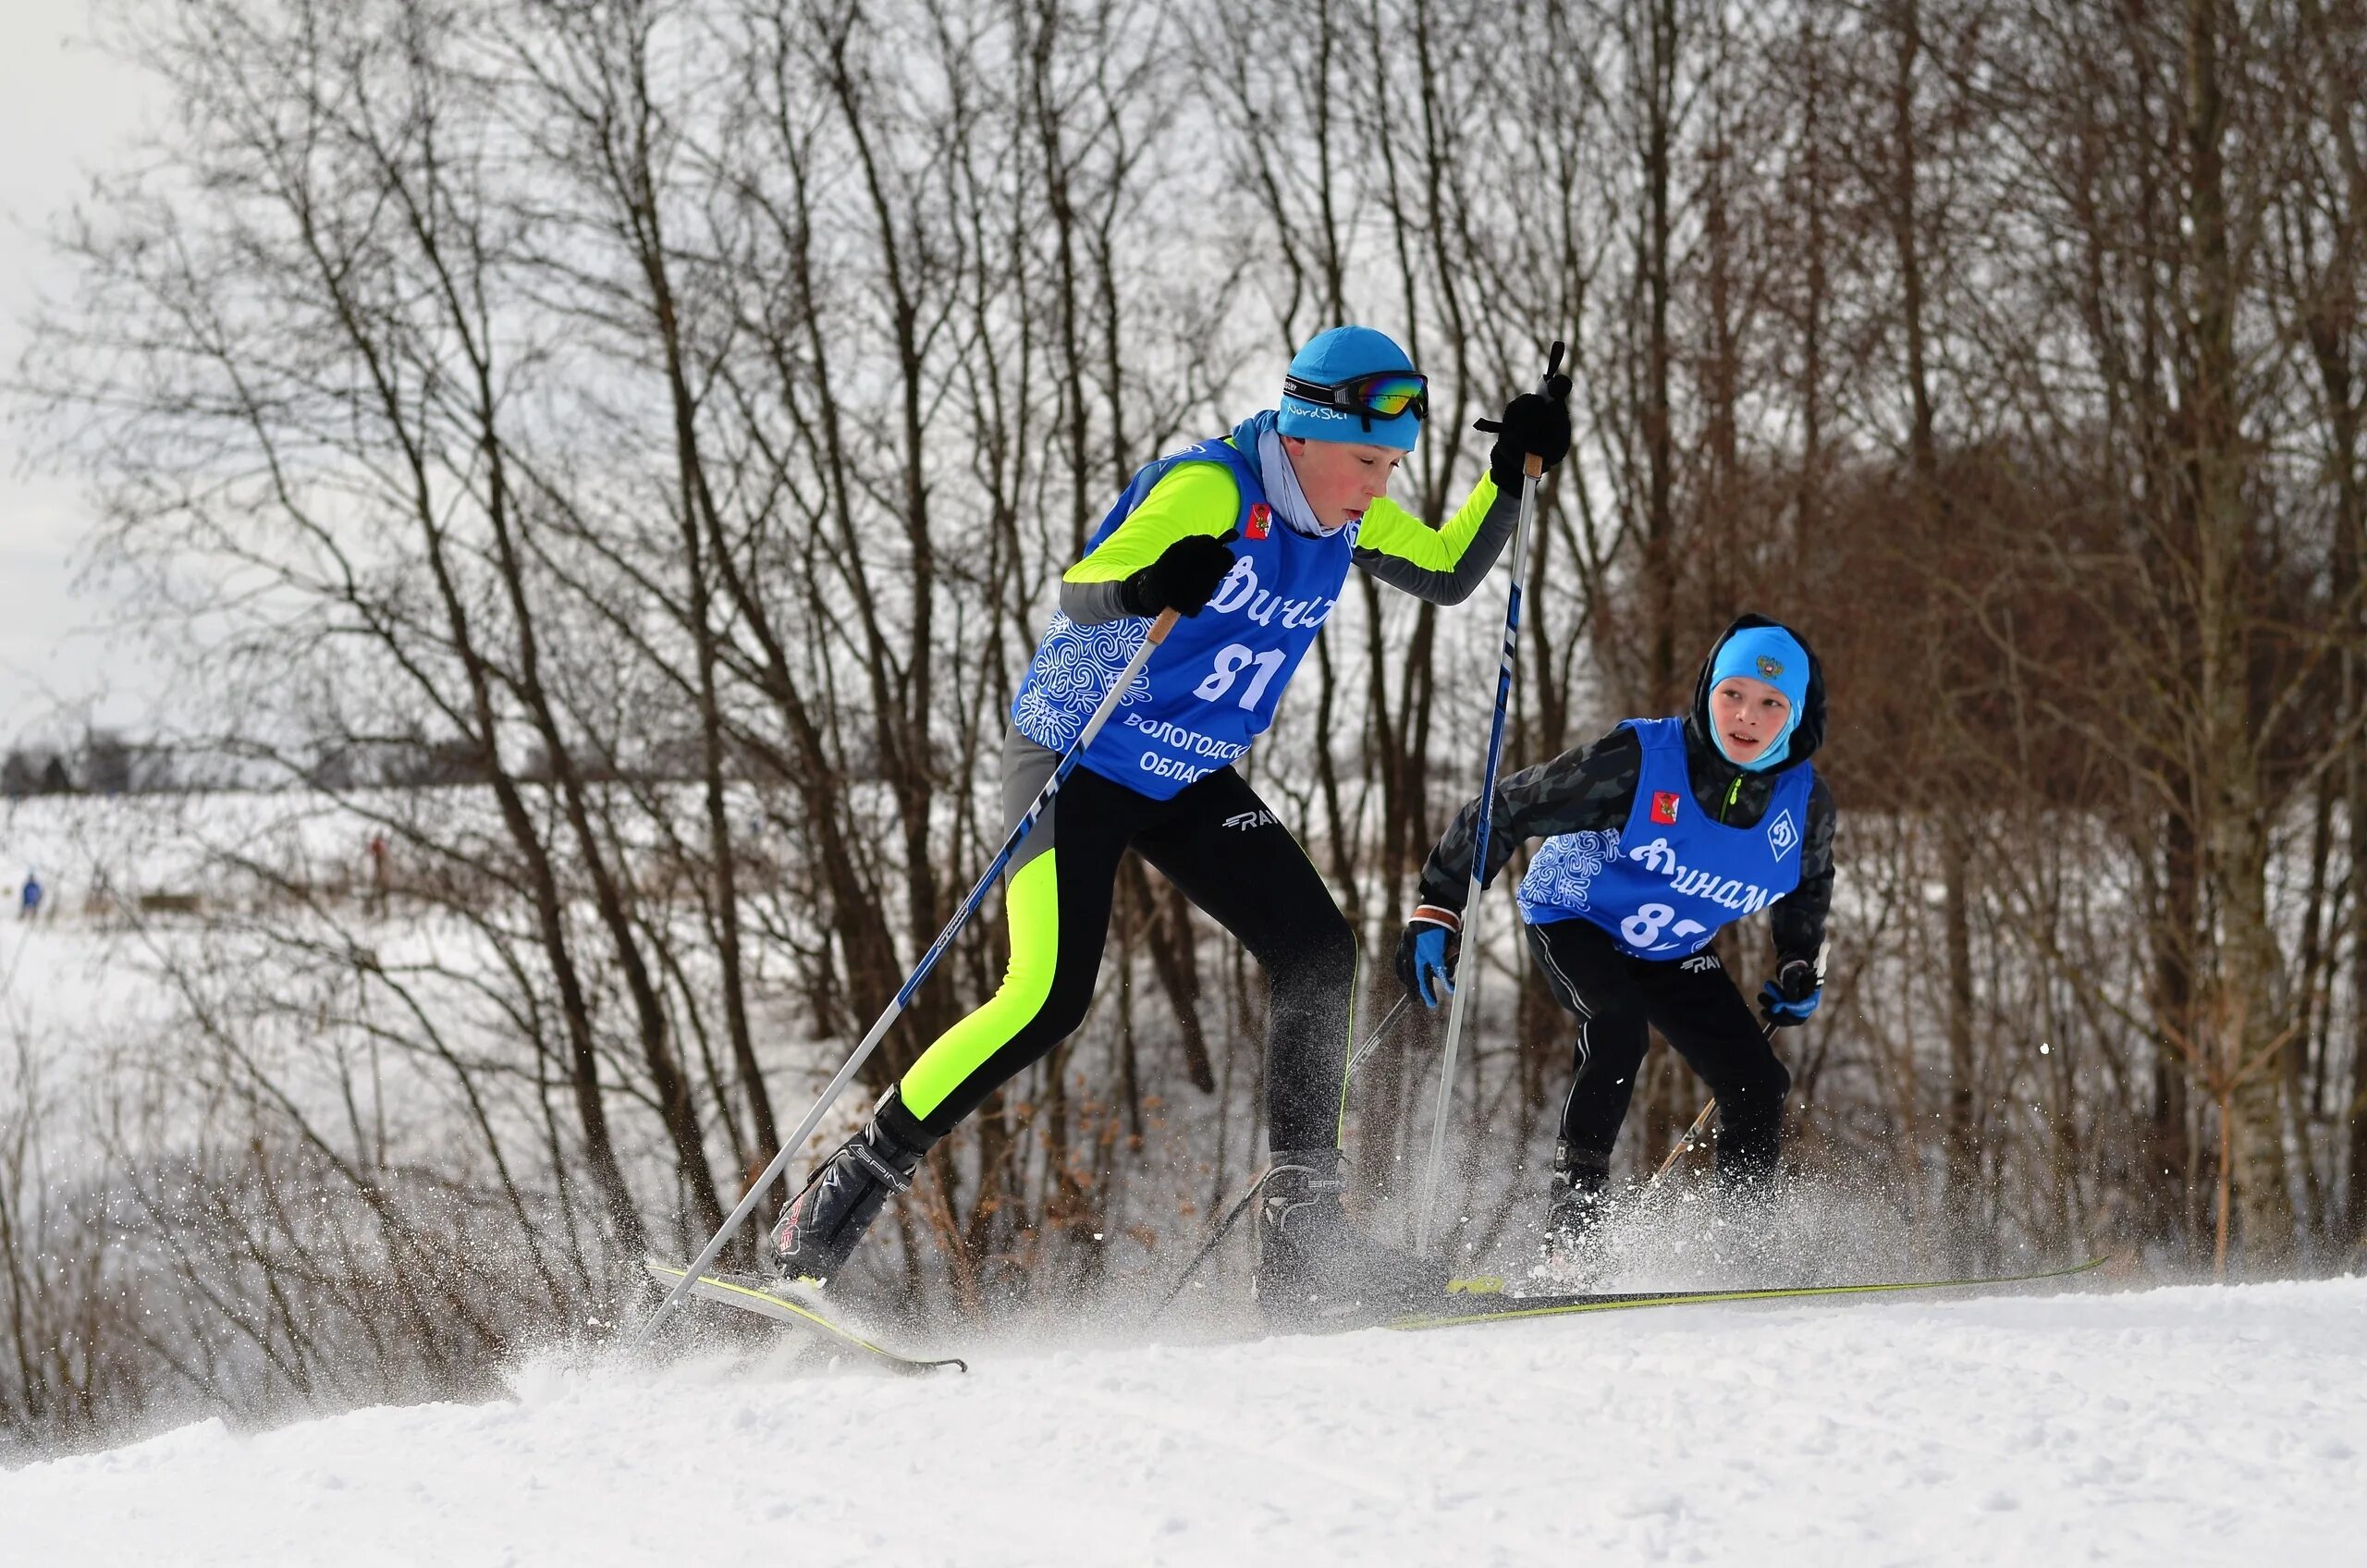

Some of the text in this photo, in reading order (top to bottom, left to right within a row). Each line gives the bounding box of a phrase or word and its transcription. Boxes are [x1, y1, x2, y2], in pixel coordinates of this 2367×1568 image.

[1192, 643, 1287, 712] 81
[1139, 751, 1217, 784] ОБЛАС
[852, 1145, 909, 1193] SPINE
